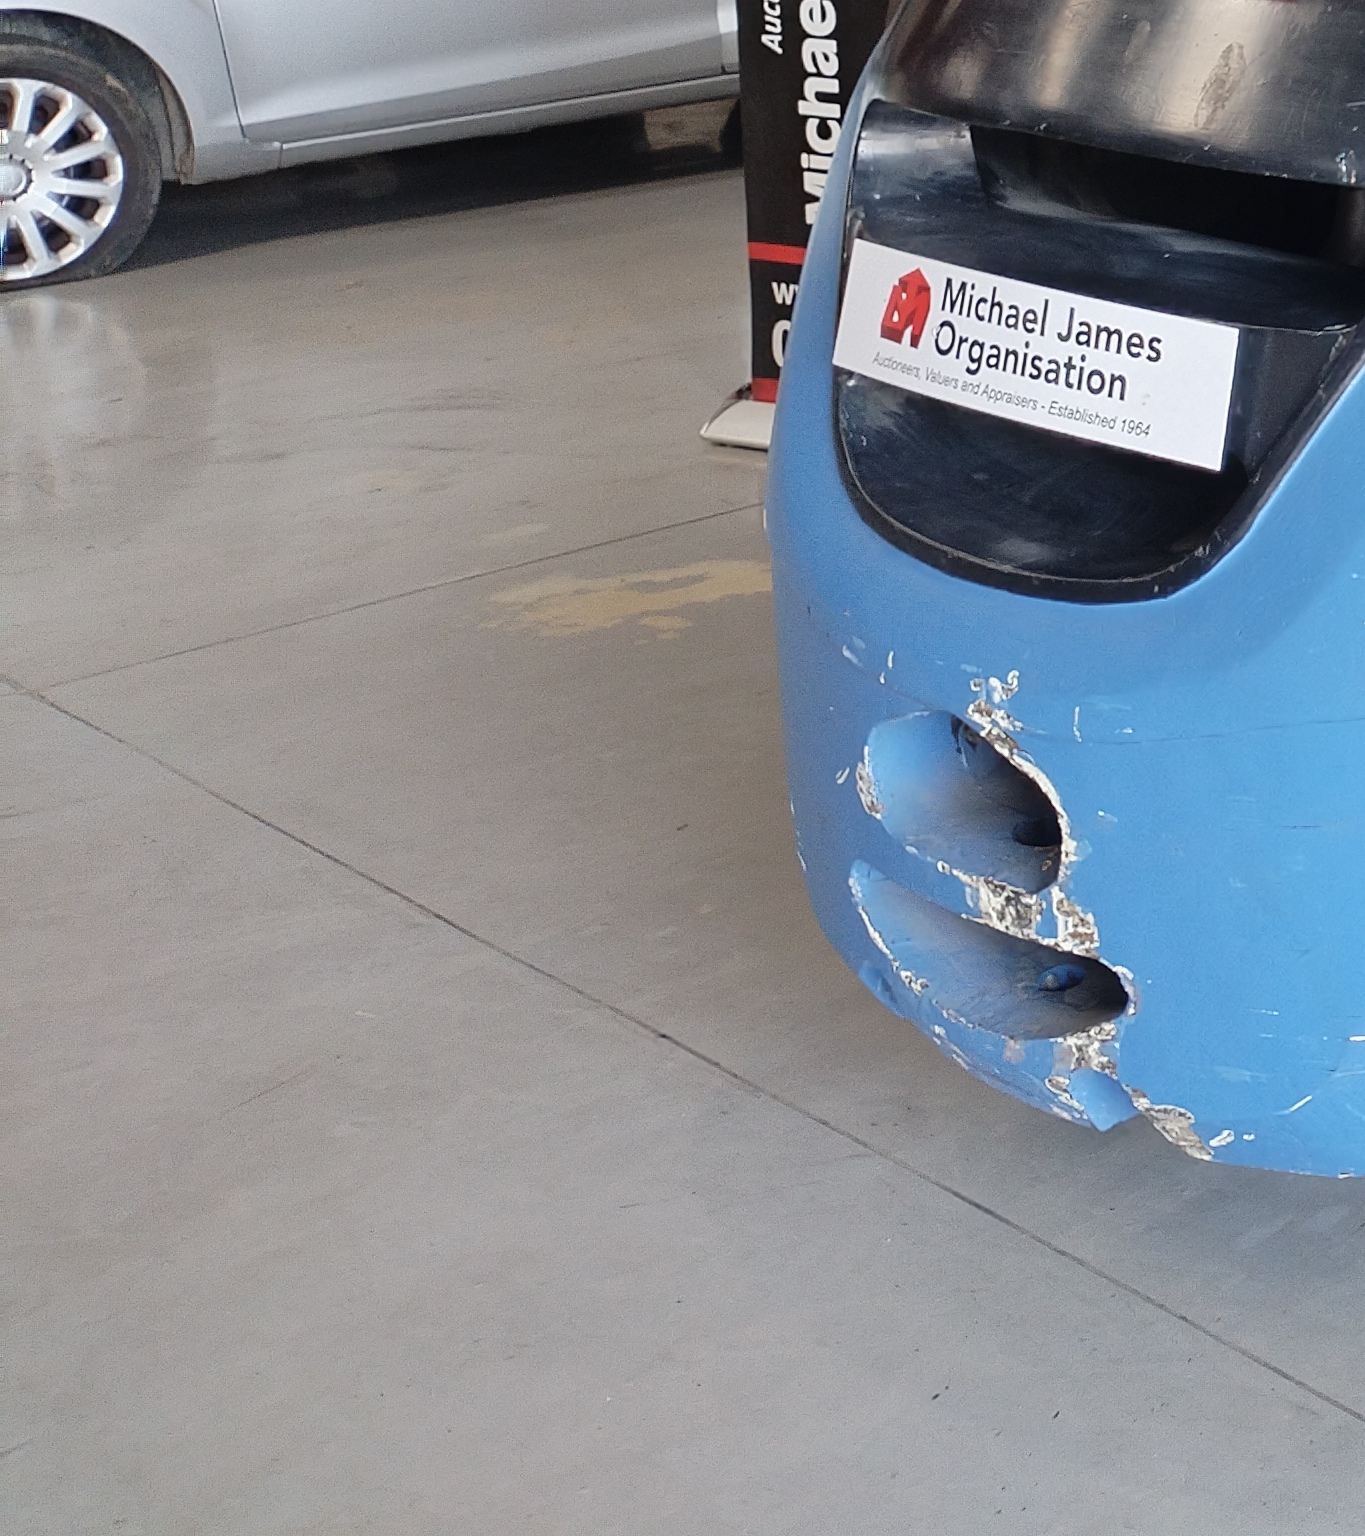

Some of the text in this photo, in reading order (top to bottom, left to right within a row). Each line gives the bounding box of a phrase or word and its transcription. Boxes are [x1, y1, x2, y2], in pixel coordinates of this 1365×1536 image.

[933, 320, 1128, 402] Organisation
[940, 277, 1163, 362] Michael James
[872, 351, 922, 381] Auctioneers,
[925, 366, 958, 391] Valuers
[960, 376, 981, 396] and
[980, 386, 1038, 412] Appraisers
[1048, 400, 1117, 431] Established
[1121, 420, 1152, 439] 1964
